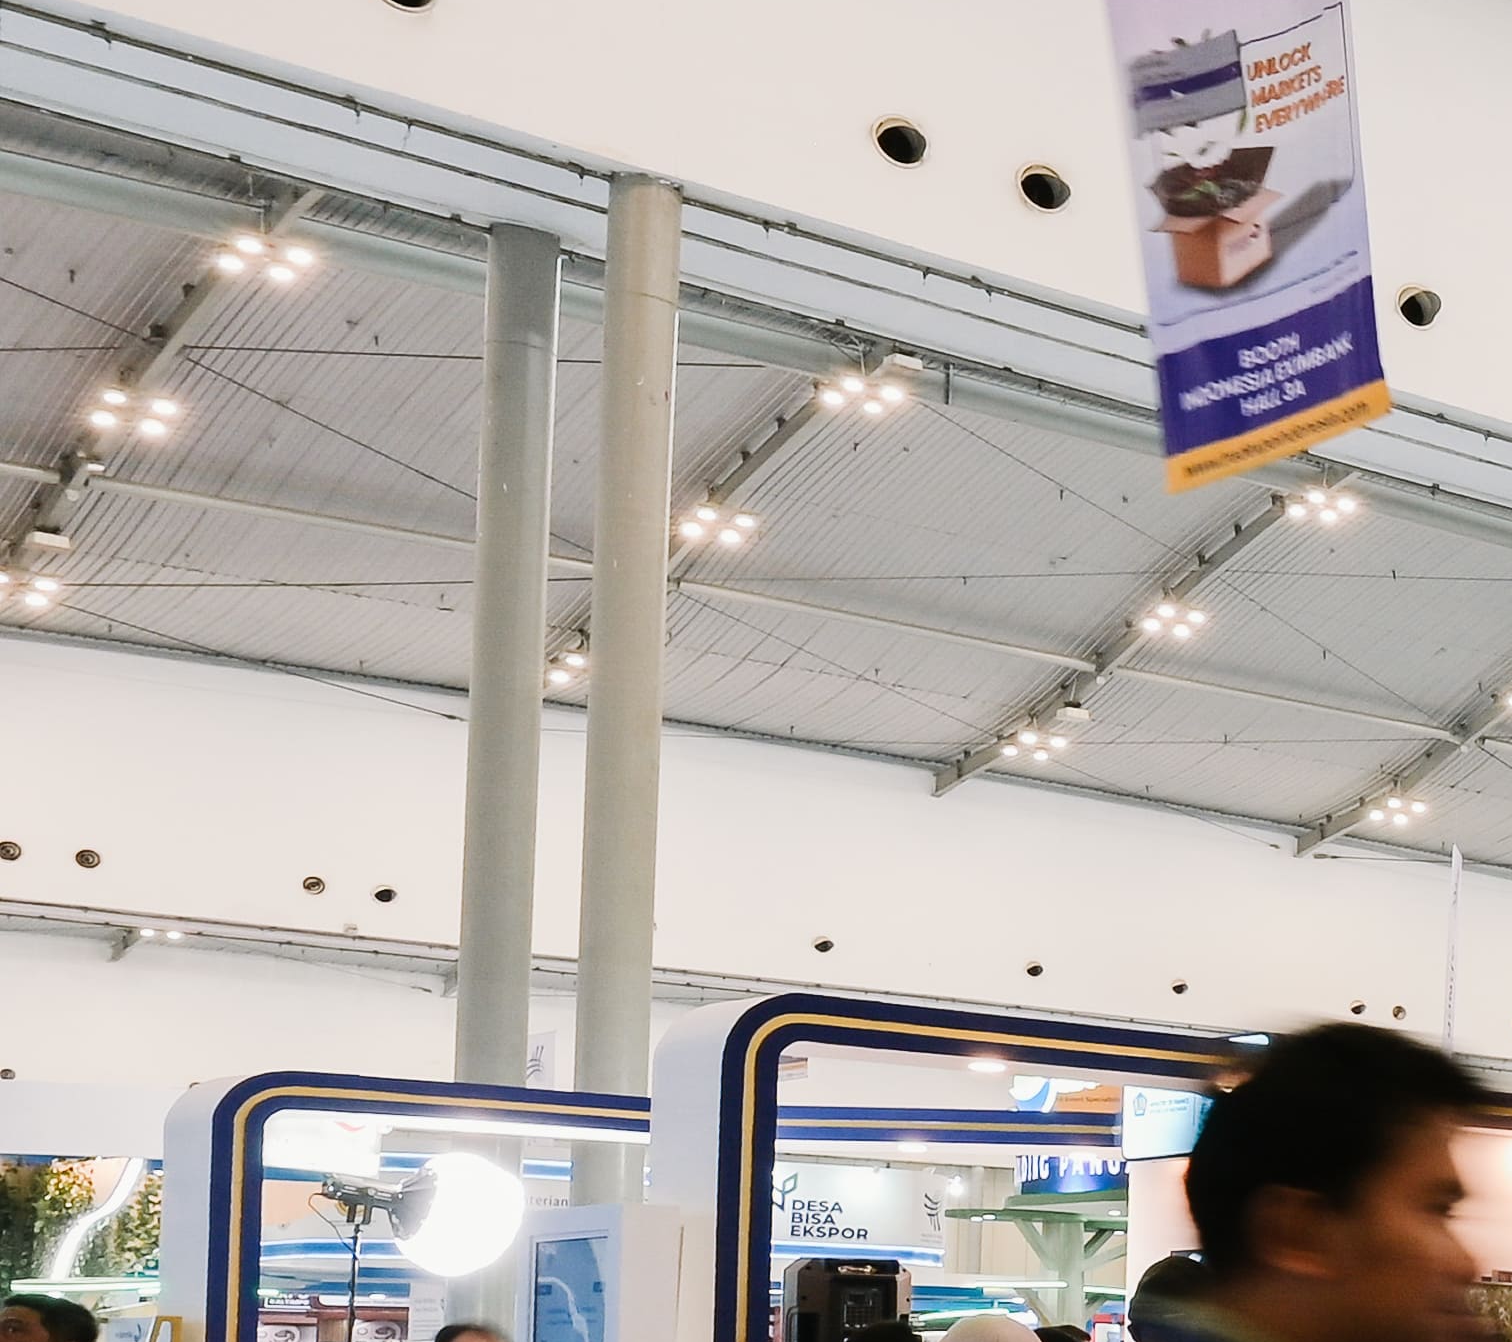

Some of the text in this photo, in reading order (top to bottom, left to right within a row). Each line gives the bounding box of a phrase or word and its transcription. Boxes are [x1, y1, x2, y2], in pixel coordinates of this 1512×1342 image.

[1247, 41, 1312, 81] UNLOCK
[1251, 64, 1322, 108] MARKETS
[791, 1199, 844, 1214] DESA
[791, 1212, 836, 1226] BISA
[790, 1224, 869, 1241] EKSPOR
